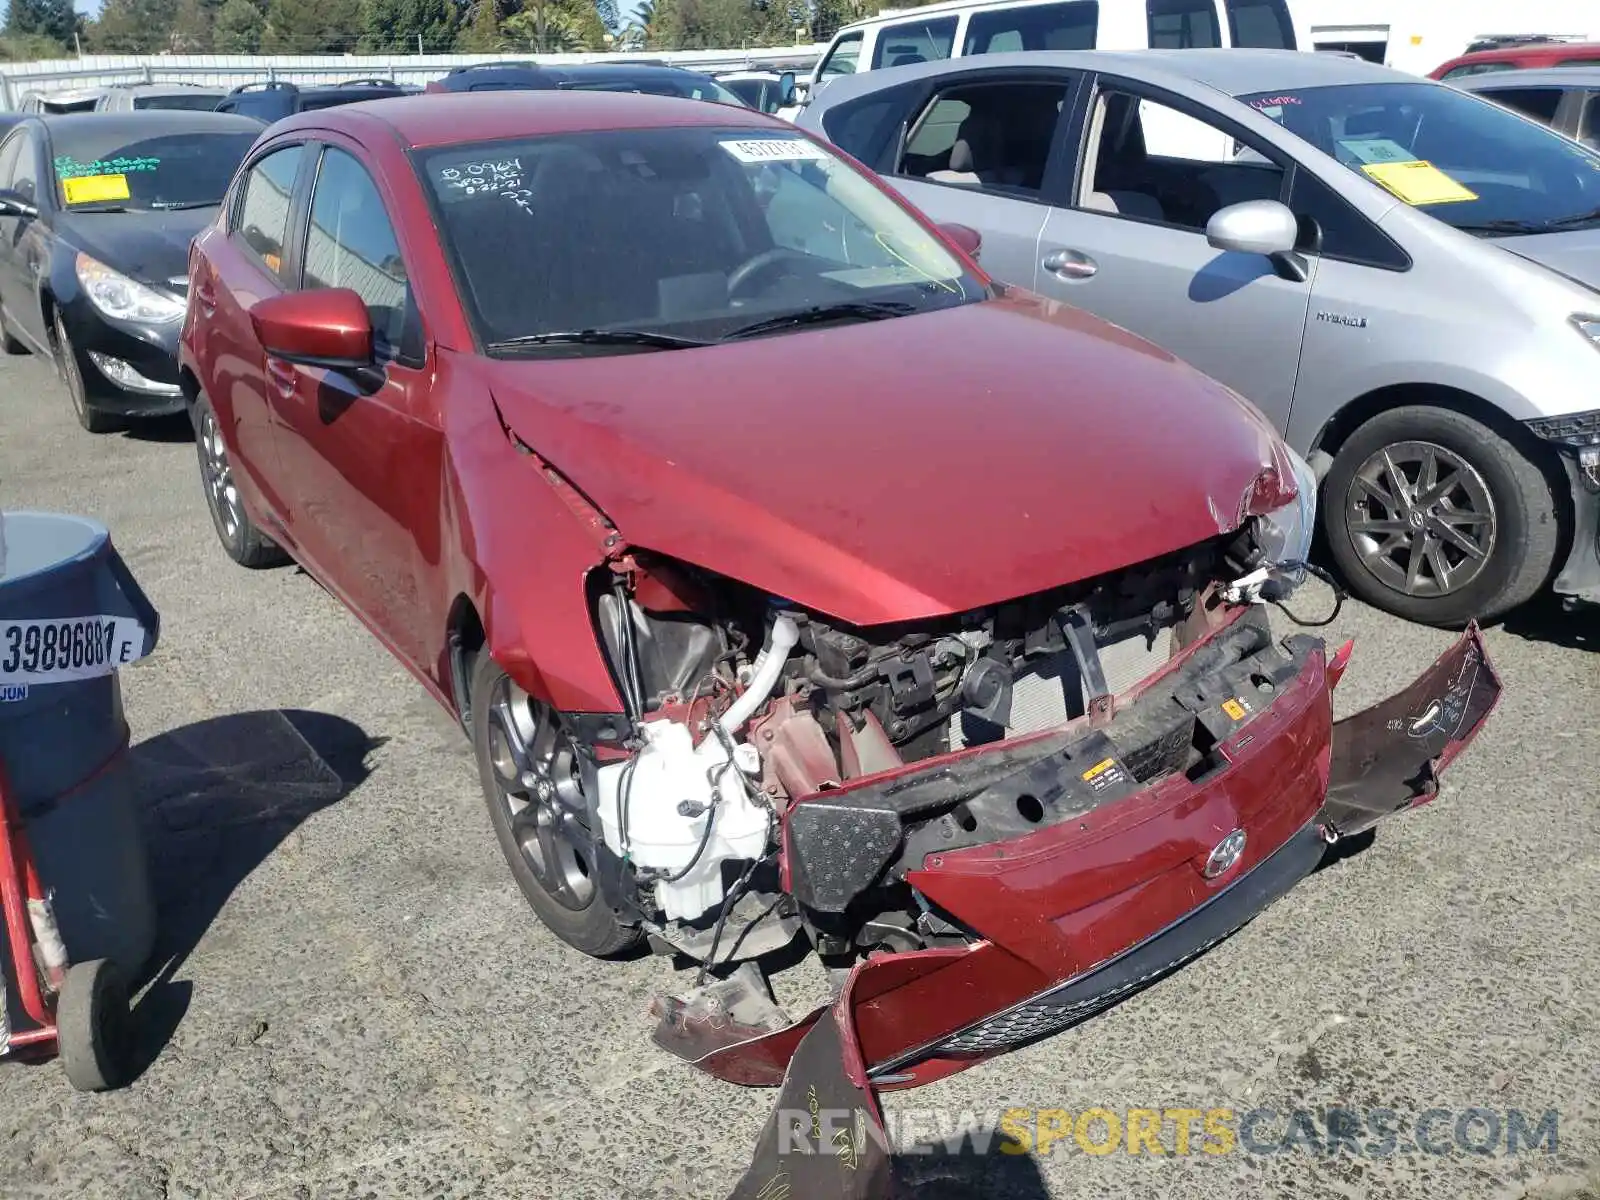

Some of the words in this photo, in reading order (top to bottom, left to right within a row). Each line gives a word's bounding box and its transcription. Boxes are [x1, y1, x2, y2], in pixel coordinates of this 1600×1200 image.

[3, 621, 115, 672] 39896881
[119, 640, 132, 663] E
[0, 687, 26, 700] JUN
